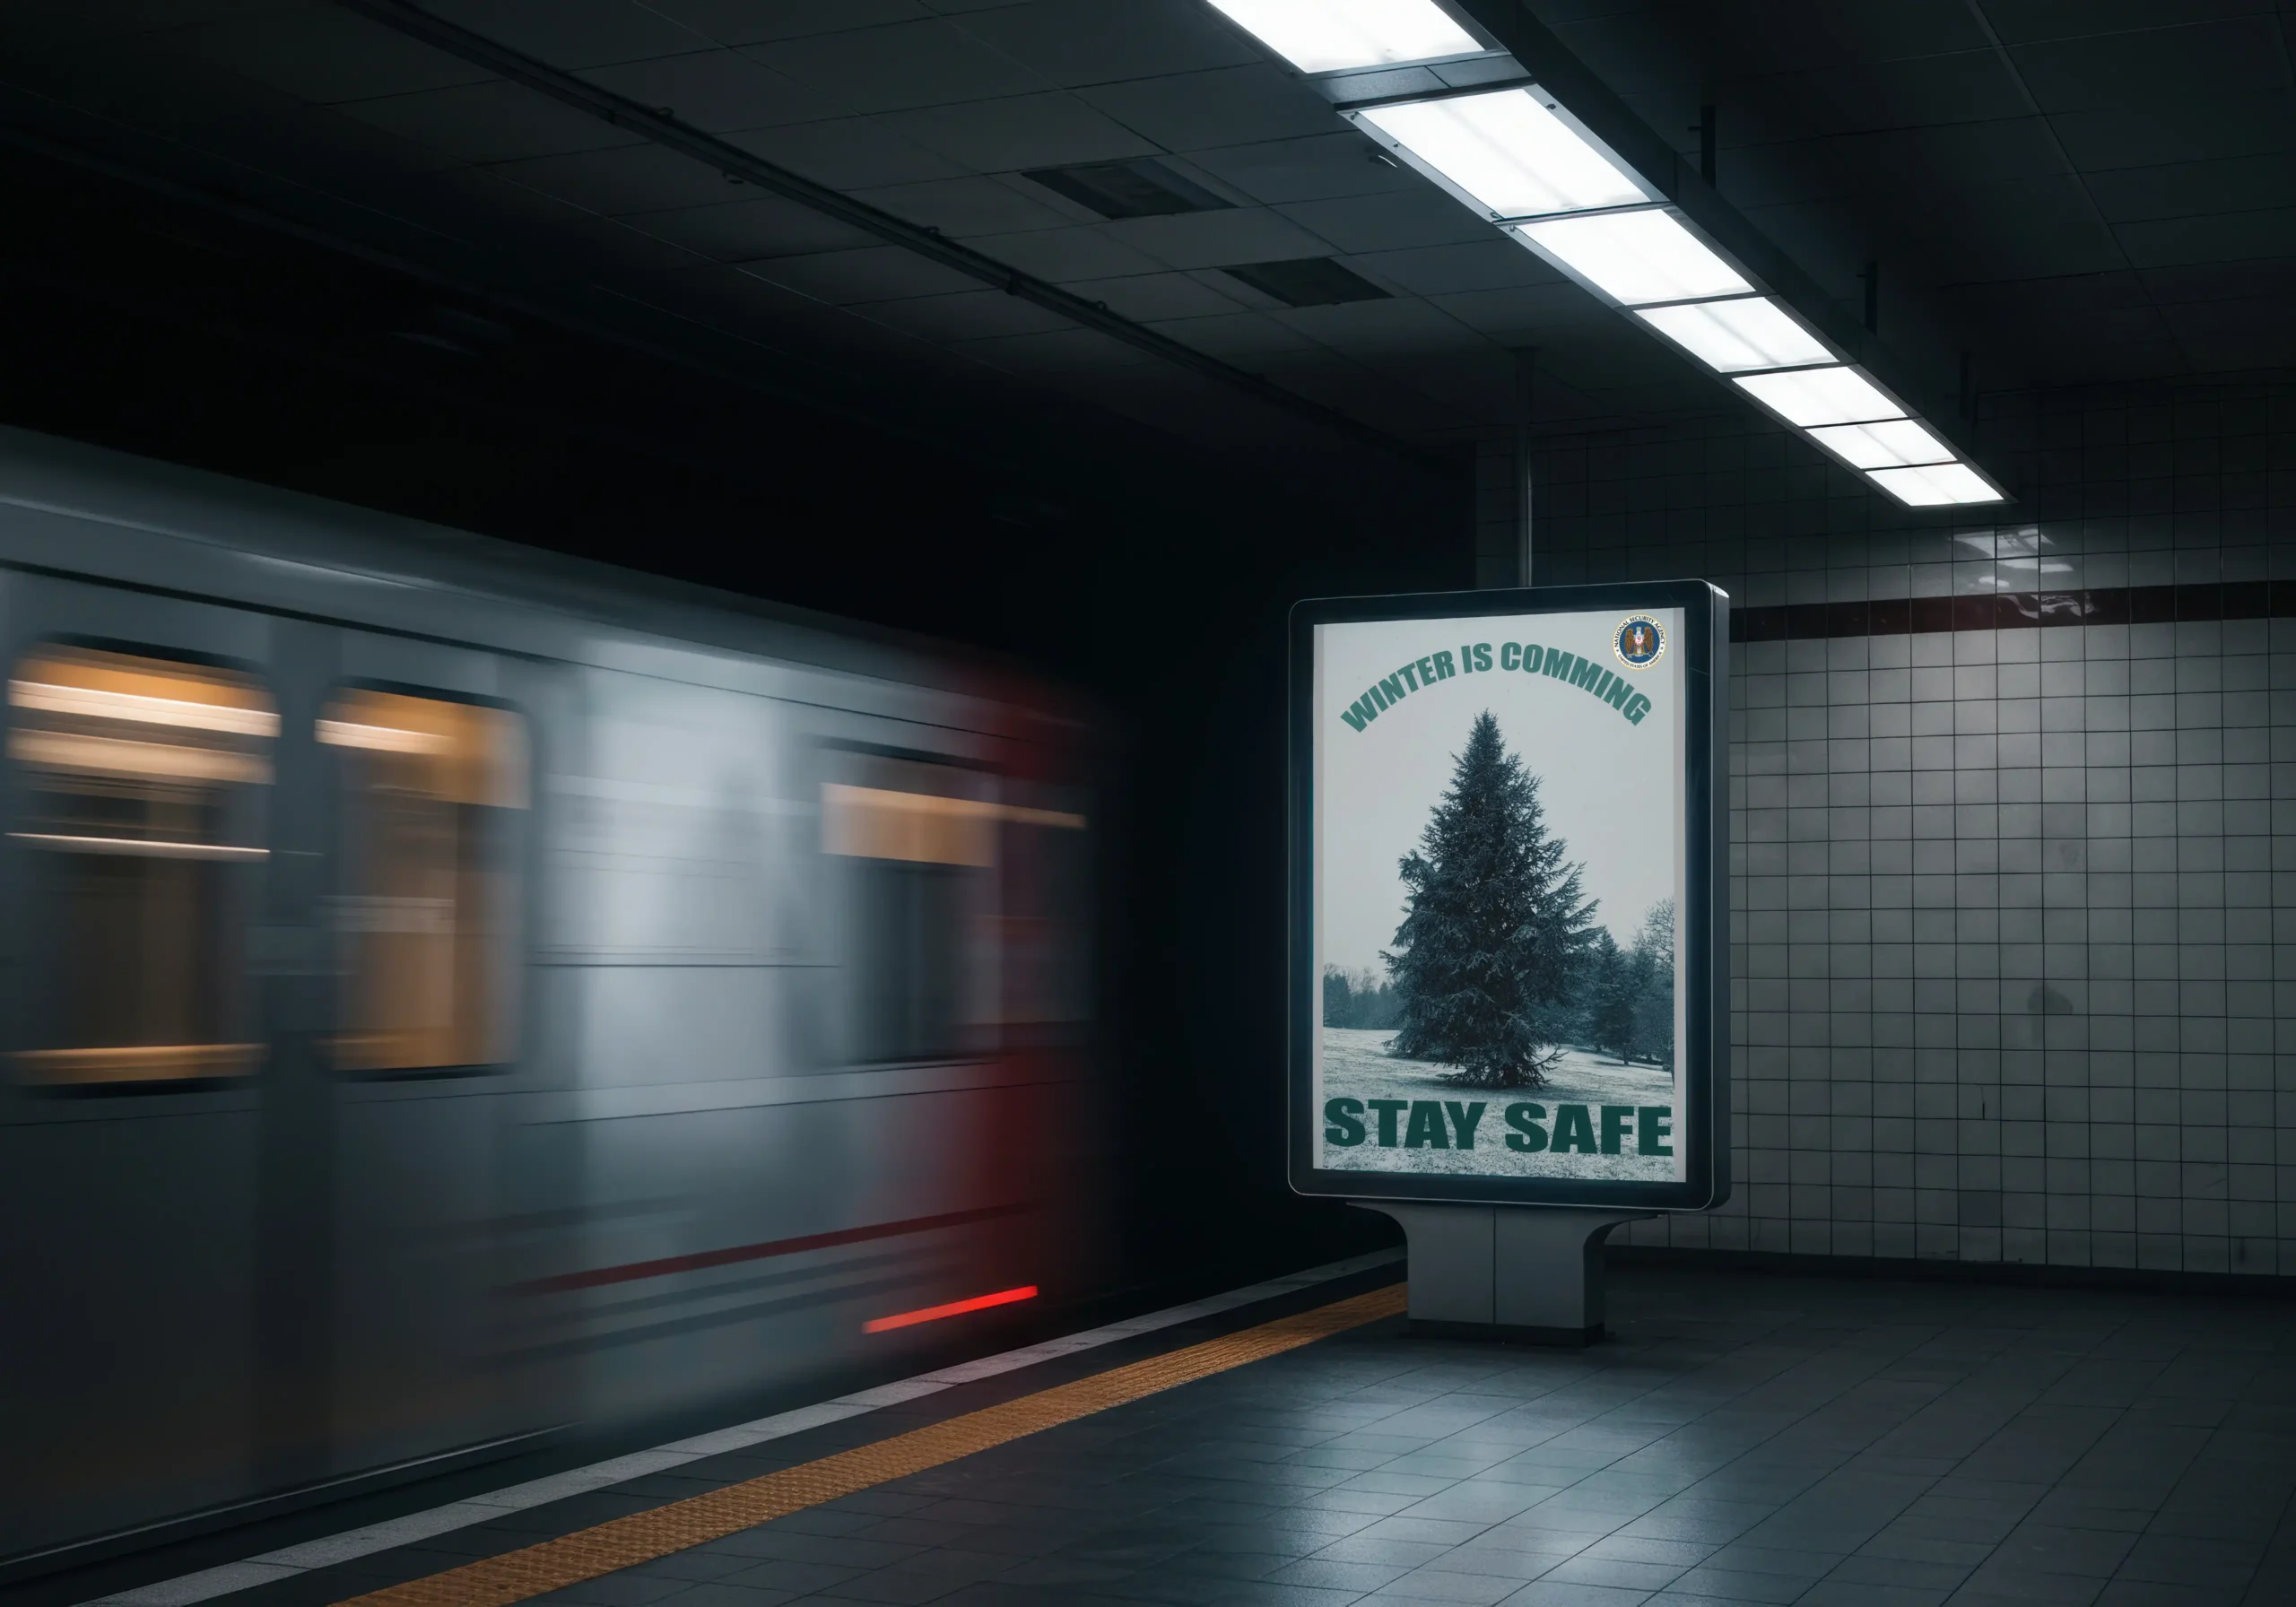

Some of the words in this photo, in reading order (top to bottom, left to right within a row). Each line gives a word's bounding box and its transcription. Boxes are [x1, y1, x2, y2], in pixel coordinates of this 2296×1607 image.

[1613, 621, 1629, 647] NATIONAL
[1629, 615, 1655, 623] SECURITY
[1655, 622, 1665, 645] AGENCY
[1340, 650, 1456, 733] WINTER
[1461, 642, 1493, 674] IS
[1500, 642, 1652, 726] COMMING
[1324, 1097, 1488, 1151] STAY
[1504, 1102, 1674, 1157] SAFE
